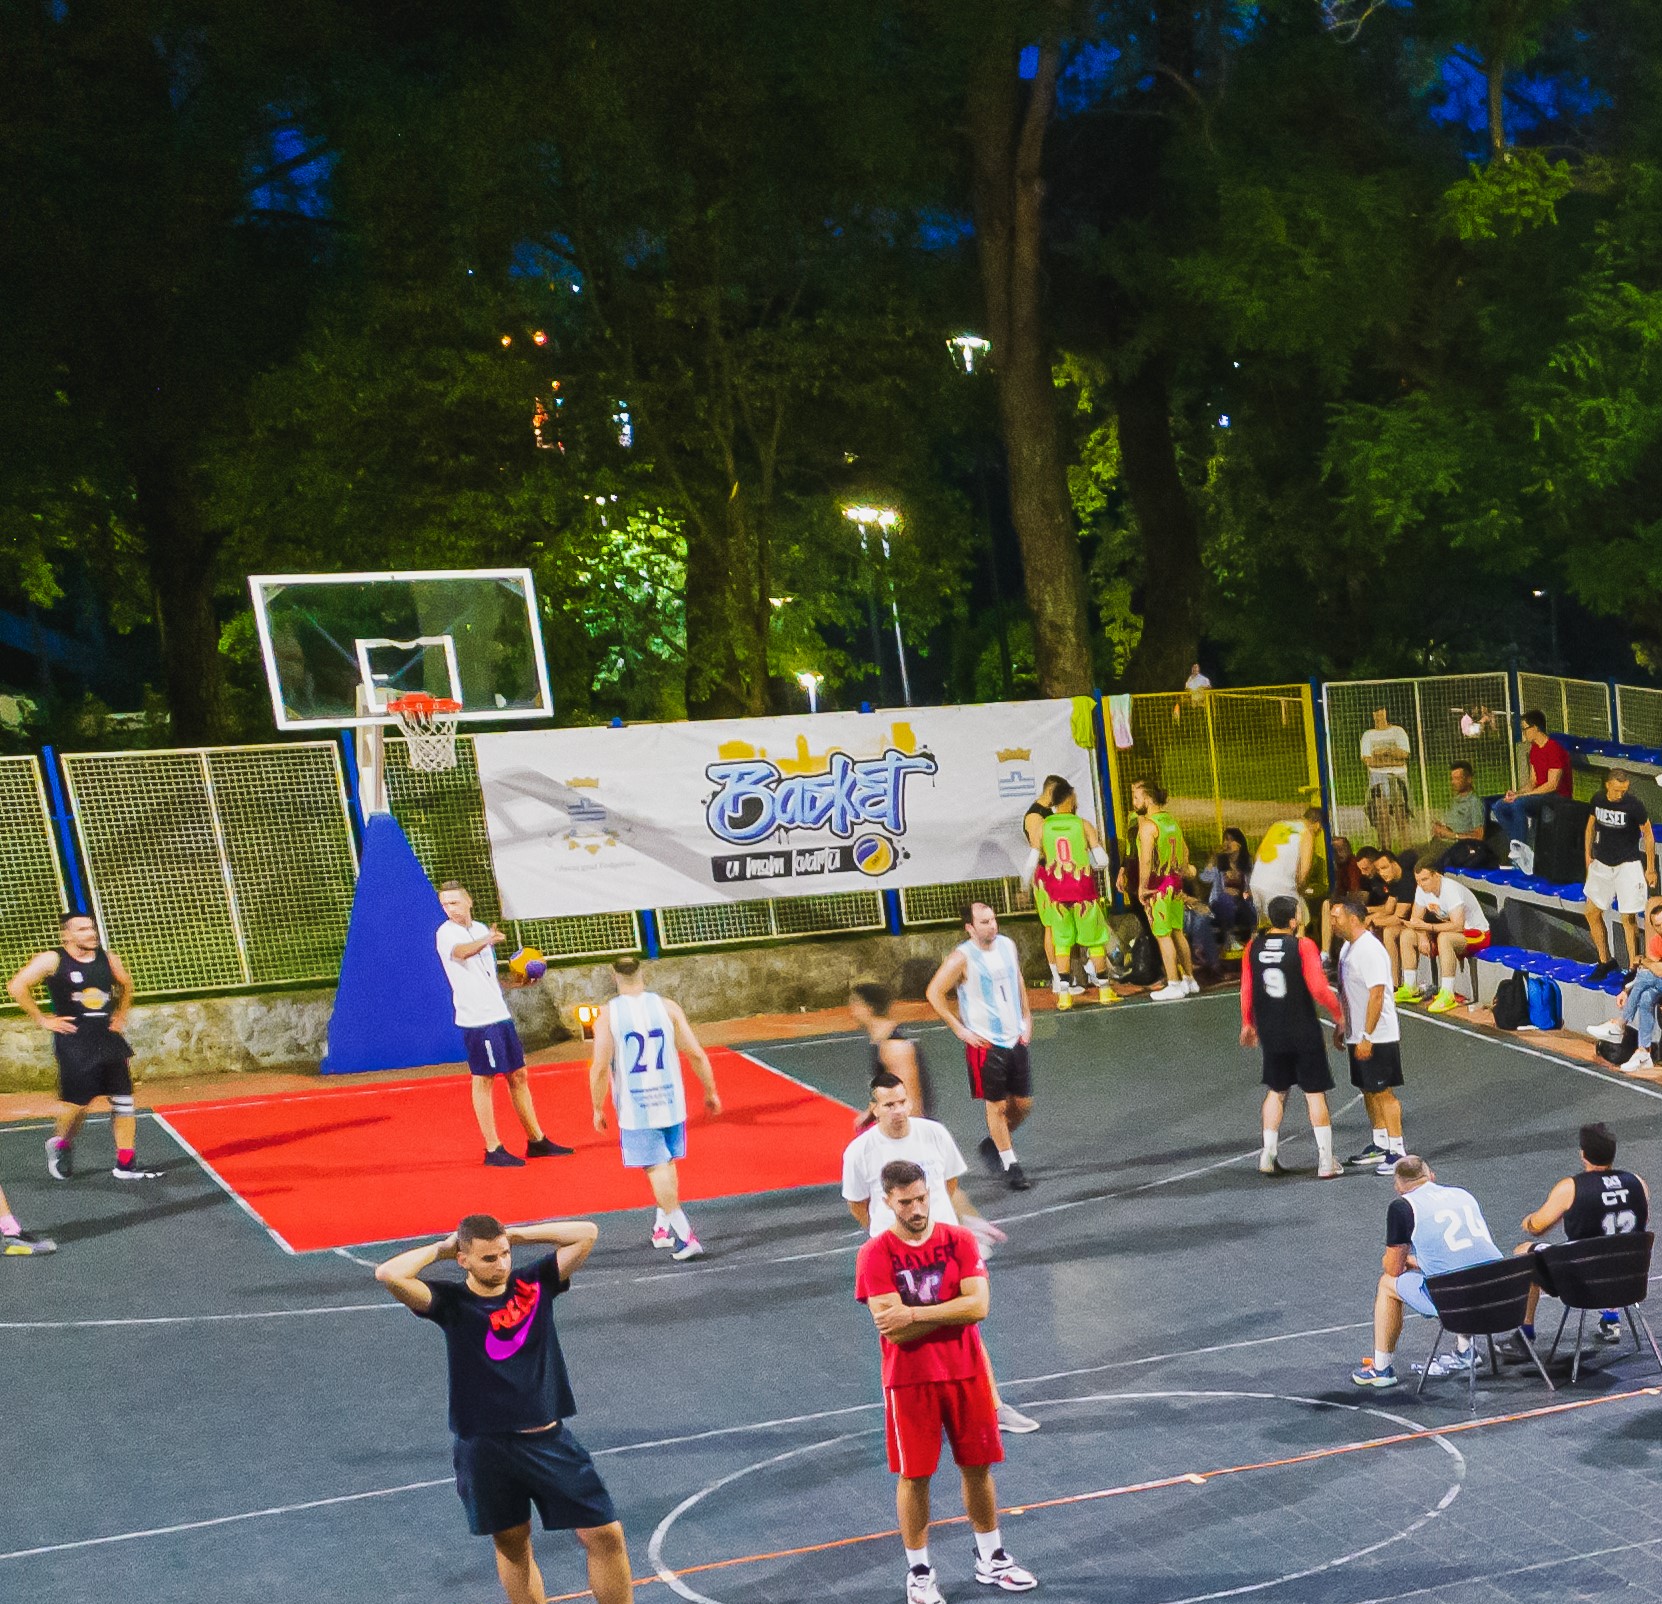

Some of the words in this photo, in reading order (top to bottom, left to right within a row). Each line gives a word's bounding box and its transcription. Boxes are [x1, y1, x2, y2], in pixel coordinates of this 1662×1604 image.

[705, 748, 938, 845] Basket
[1262, 967, 1287, 998] 9
[624, 1028, 665, 1074] 27
[1601, 1189, 1629, 1206] CT
[1434, 1204, 1492, 1252] 24
